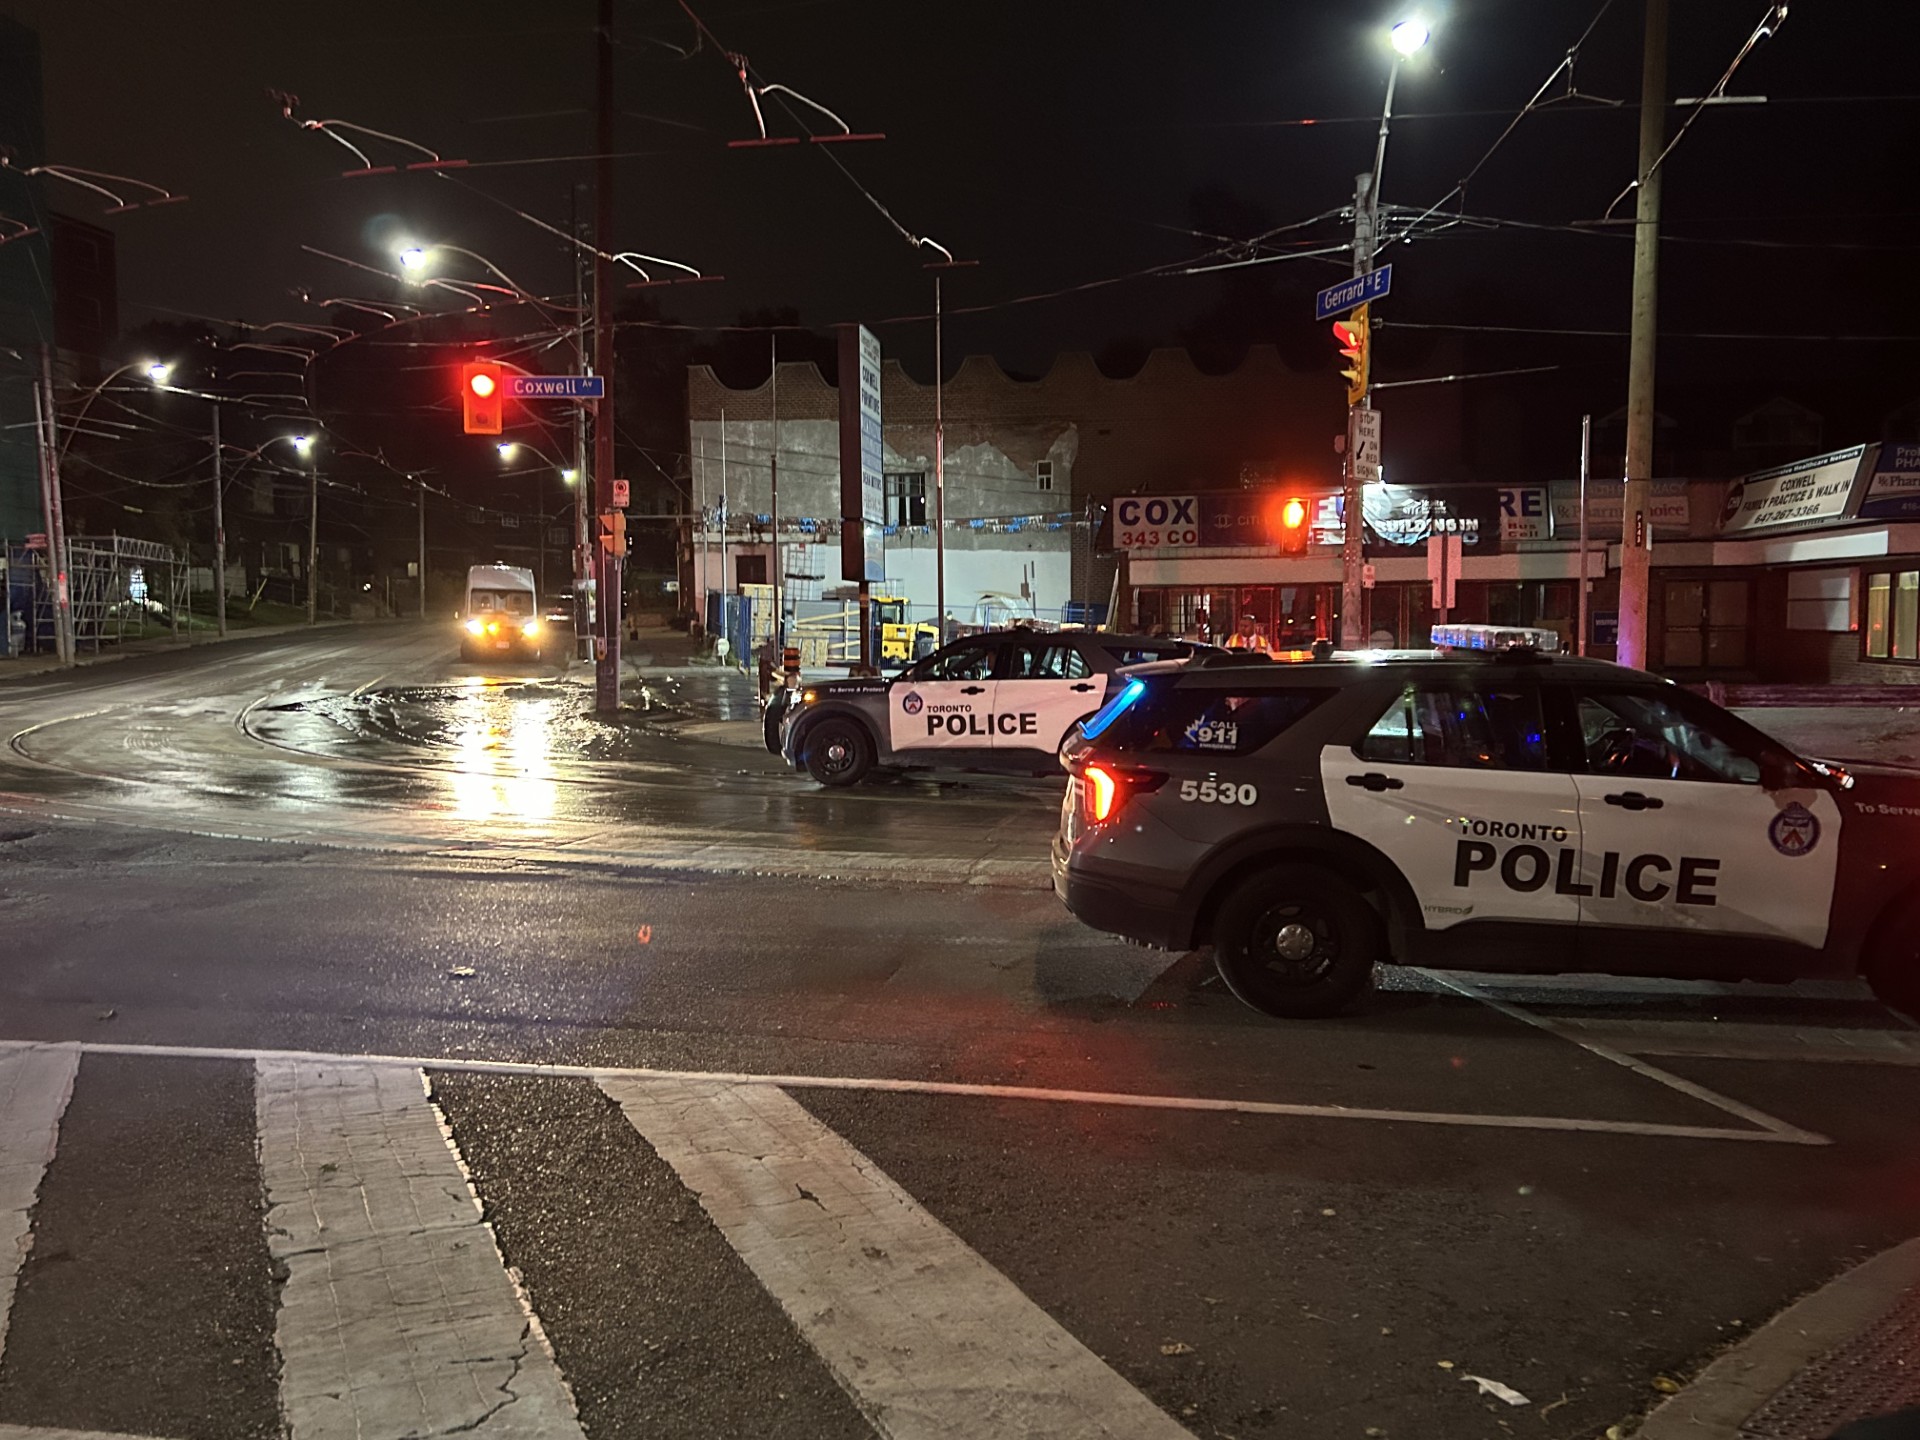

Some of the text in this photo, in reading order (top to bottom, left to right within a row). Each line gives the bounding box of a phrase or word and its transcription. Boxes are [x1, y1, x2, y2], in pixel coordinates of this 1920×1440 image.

[1324, 277, 1365, 310] Gerrard
[1374, 270, 1382, 291] E
[514, 379, 593, 394] Coxwell Av
[1360, 412, 1375, 424] STOP
[1358, 427, 1375, 438] HERE
[1369, 441, 1378, 450] ON
[1366, 453, 1377, 464] RED
[1829, 450, 1859, 463] Network
[1357, 465, 1377, 477] SIGNAL
[1780, 473, 1817, 492] COXWELL
[1769, 490, 1806, 507] PRACTICE
[1807, 489, 1813, 499] &
[1815, 484, 1839, 498] WALK
[1840, 480, 1850, 492] IN
[1754, 503, 1820, 524] 647-267-3366
[1458, 518, 1479, 532] IN
[1122, 532, 1159, 545] 343
[927, 705, 972, 713] TORONTO
[927, 713, 1038, 735] POLICE
[1210, 720, 1238, 729] CALL
[1179, 780, 1258, 806] 5530
[1854, 801, 1920, 817] To Serve
[1460, 818, 1568, 842] TORONTO
[1454, 839, 1720, 906] POLICE
[1423, 904, 1464, 915] HYBRID
